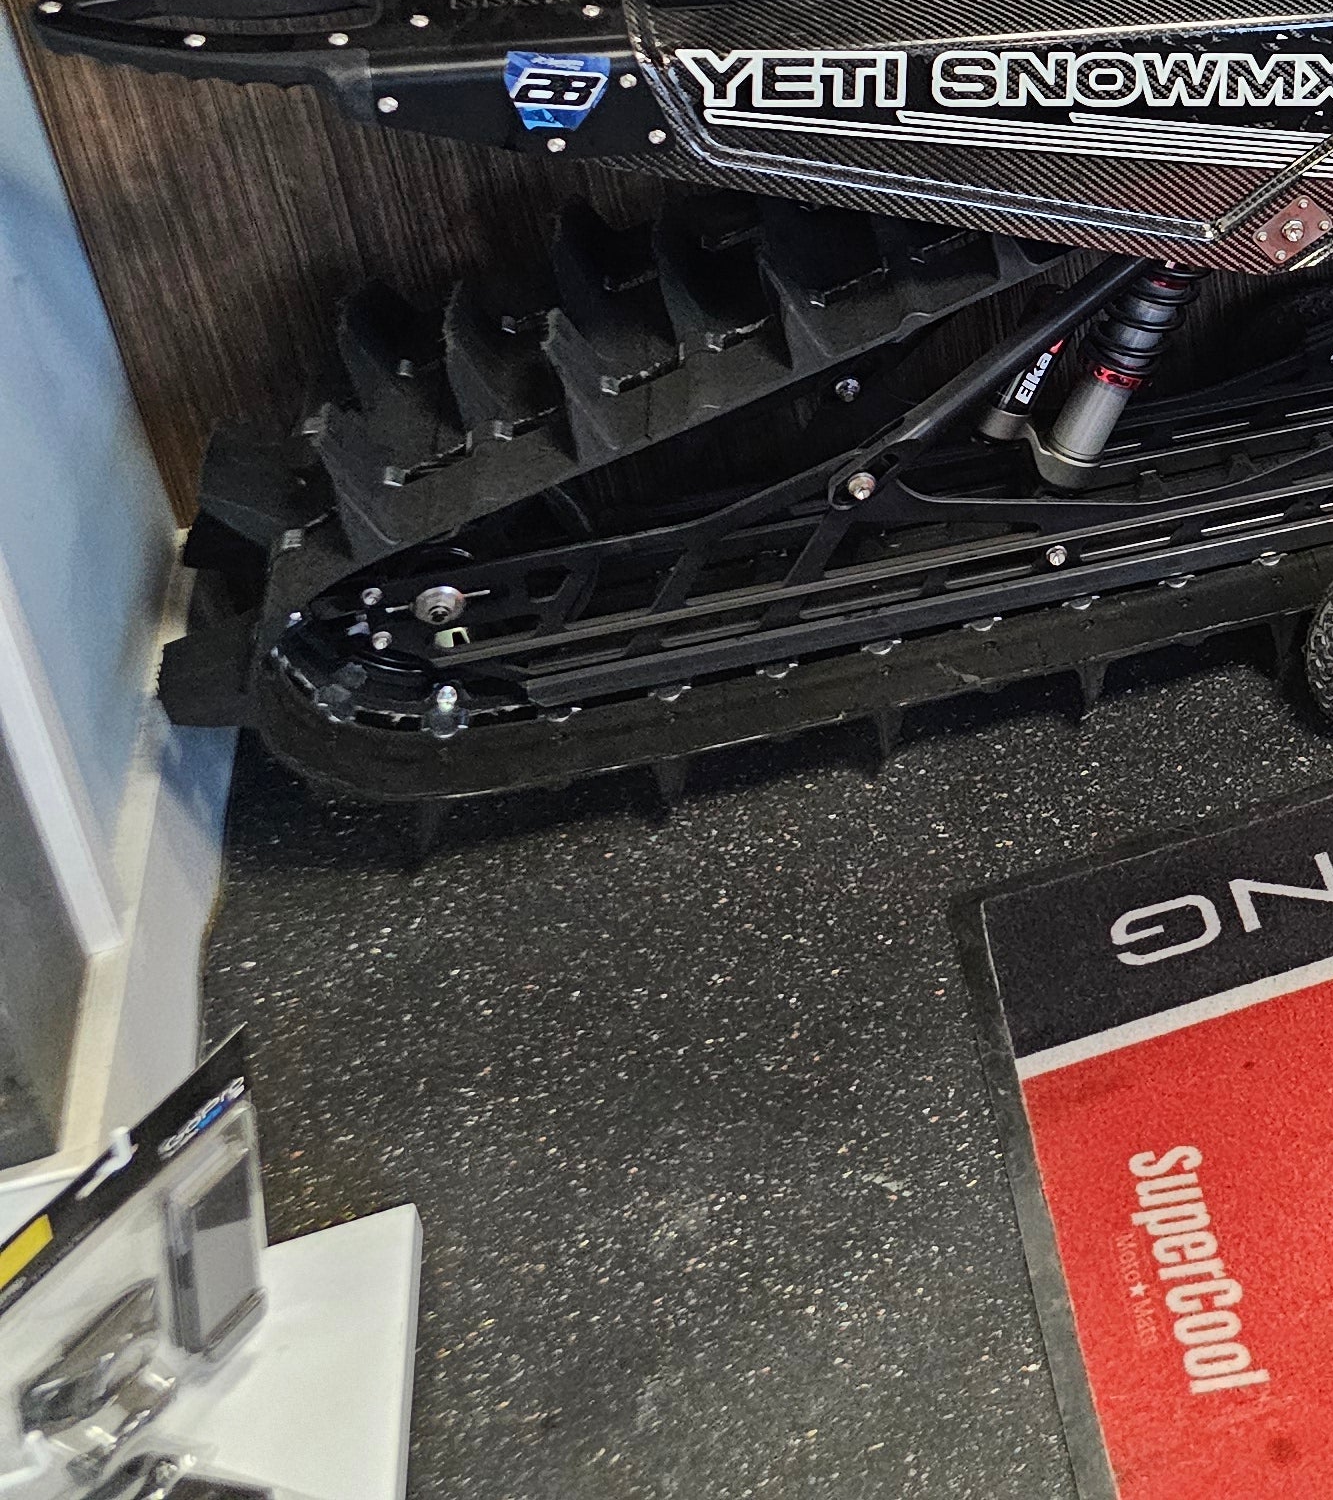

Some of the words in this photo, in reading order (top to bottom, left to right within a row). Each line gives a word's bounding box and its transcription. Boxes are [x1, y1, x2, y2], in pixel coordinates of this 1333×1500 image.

[514, 71, 602, 107] 28
[675, 48, 907, 108] YETI
[1014, 351, 1053, 405] Elka
